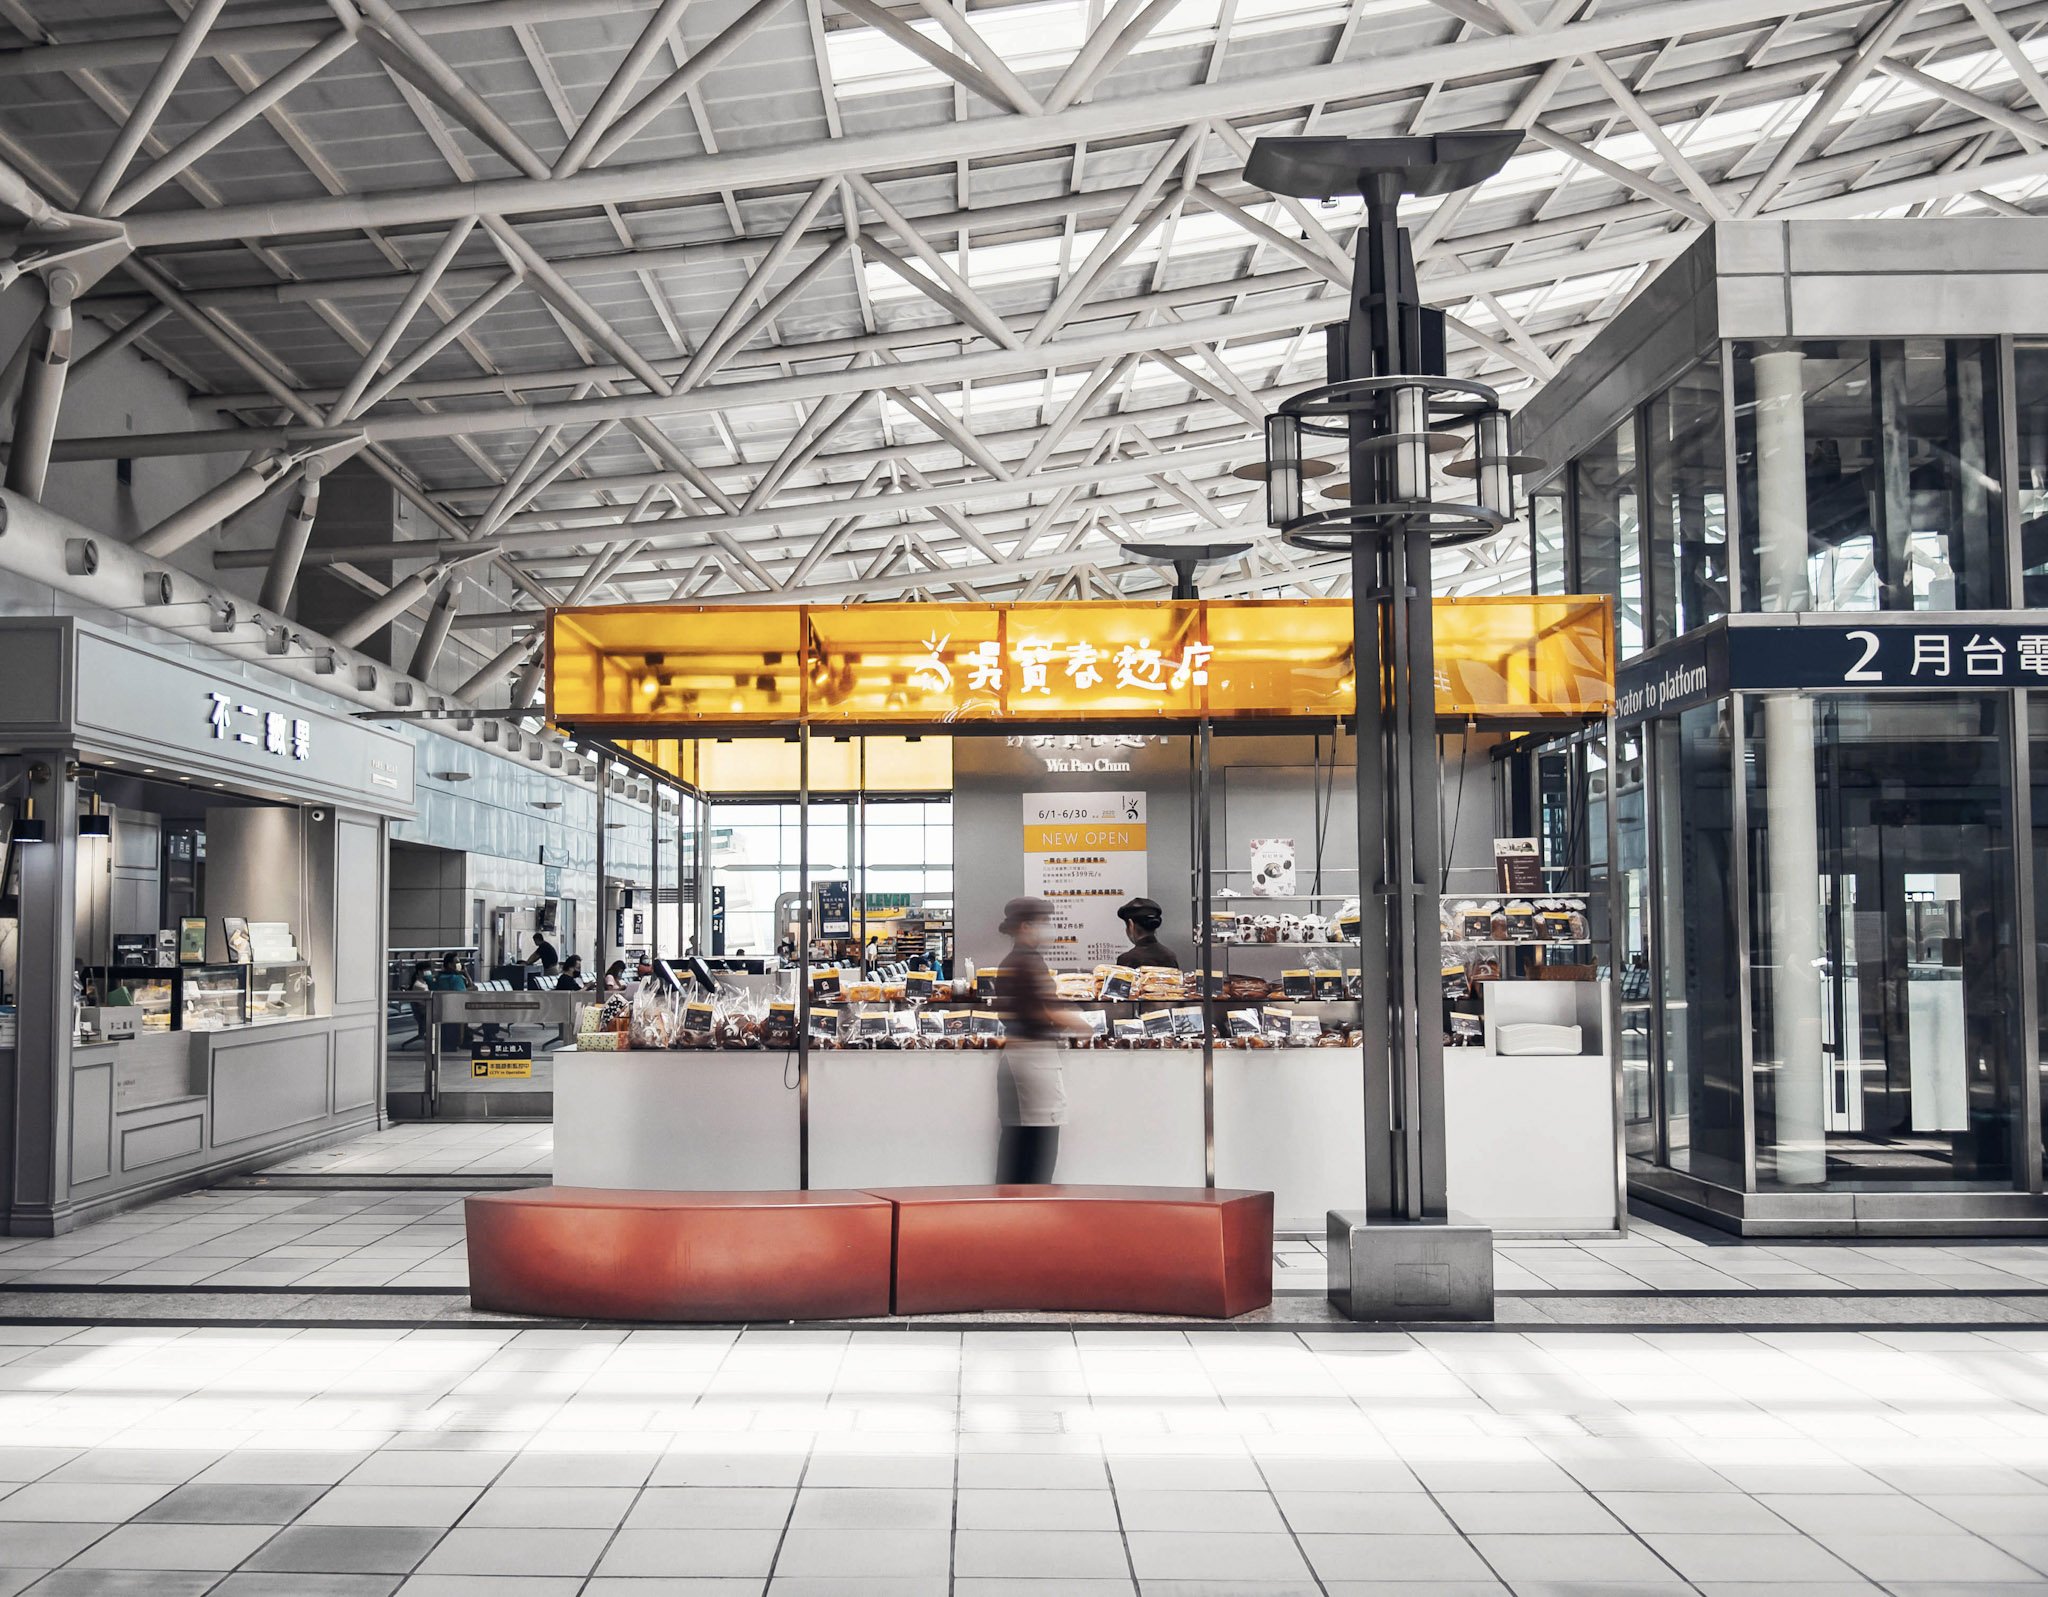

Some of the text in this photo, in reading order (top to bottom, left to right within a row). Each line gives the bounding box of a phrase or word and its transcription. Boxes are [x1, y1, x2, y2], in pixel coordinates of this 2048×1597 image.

[1844, 631, 2048, 681] 2 月台電
[1615, 664, 1707, 719] evator to platform
[1044, 758, 1130, 772] Wu Pao Chun
[1038, 809, 1088, 820] 6/1-6/30
[1042, 831, 1129, 845] NEW OPEN
